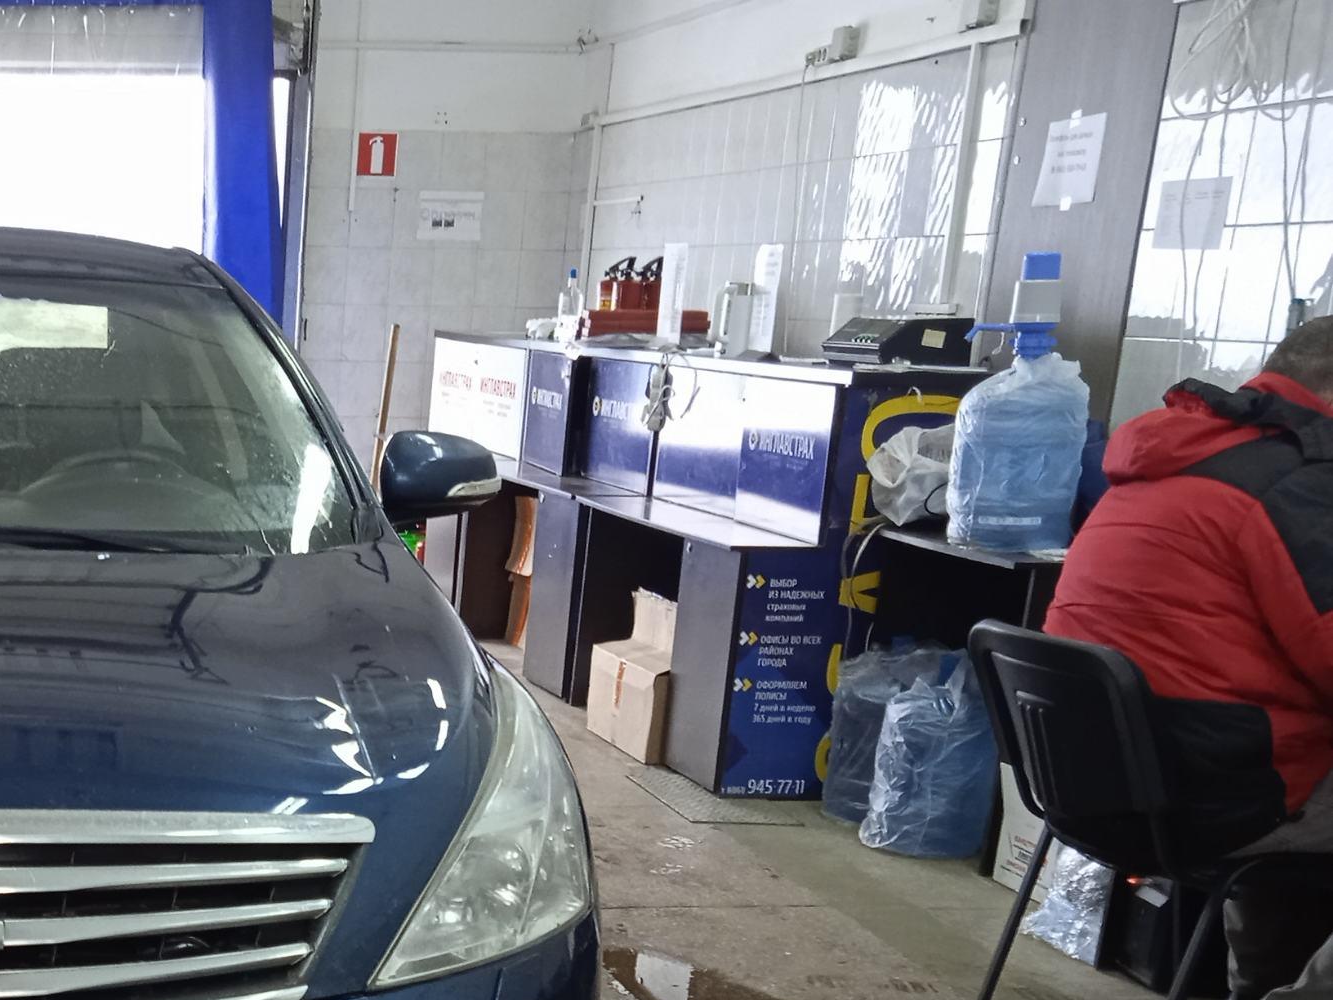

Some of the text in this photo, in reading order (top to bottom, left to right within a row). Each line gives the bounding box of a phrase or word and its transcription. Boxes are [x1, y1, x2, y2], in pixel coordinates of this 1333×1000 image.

[759, 431, 816, 460] ИНГЛАВСТРАХ
[769, 578, 798, 588] ВЫБОР
[768, 590, 826, 600] ИЗ НАДЕЖНЫХ
[760, 635, 822, 645] ОФИСЫ ВО ВСЕХ
[758, 646, 794, 655] РАЙОНАХ
[757, 658, 787, 667] ГОРОДА
[756, 680, 808, 690] ОФОРМЛЯЕМ
[754, 692, 787, 701] ПОЛИСЫ
[753, 703, 759, 711] 7
[760, 703, 778, 713] дней
[752, 715, 765, 723] 365
